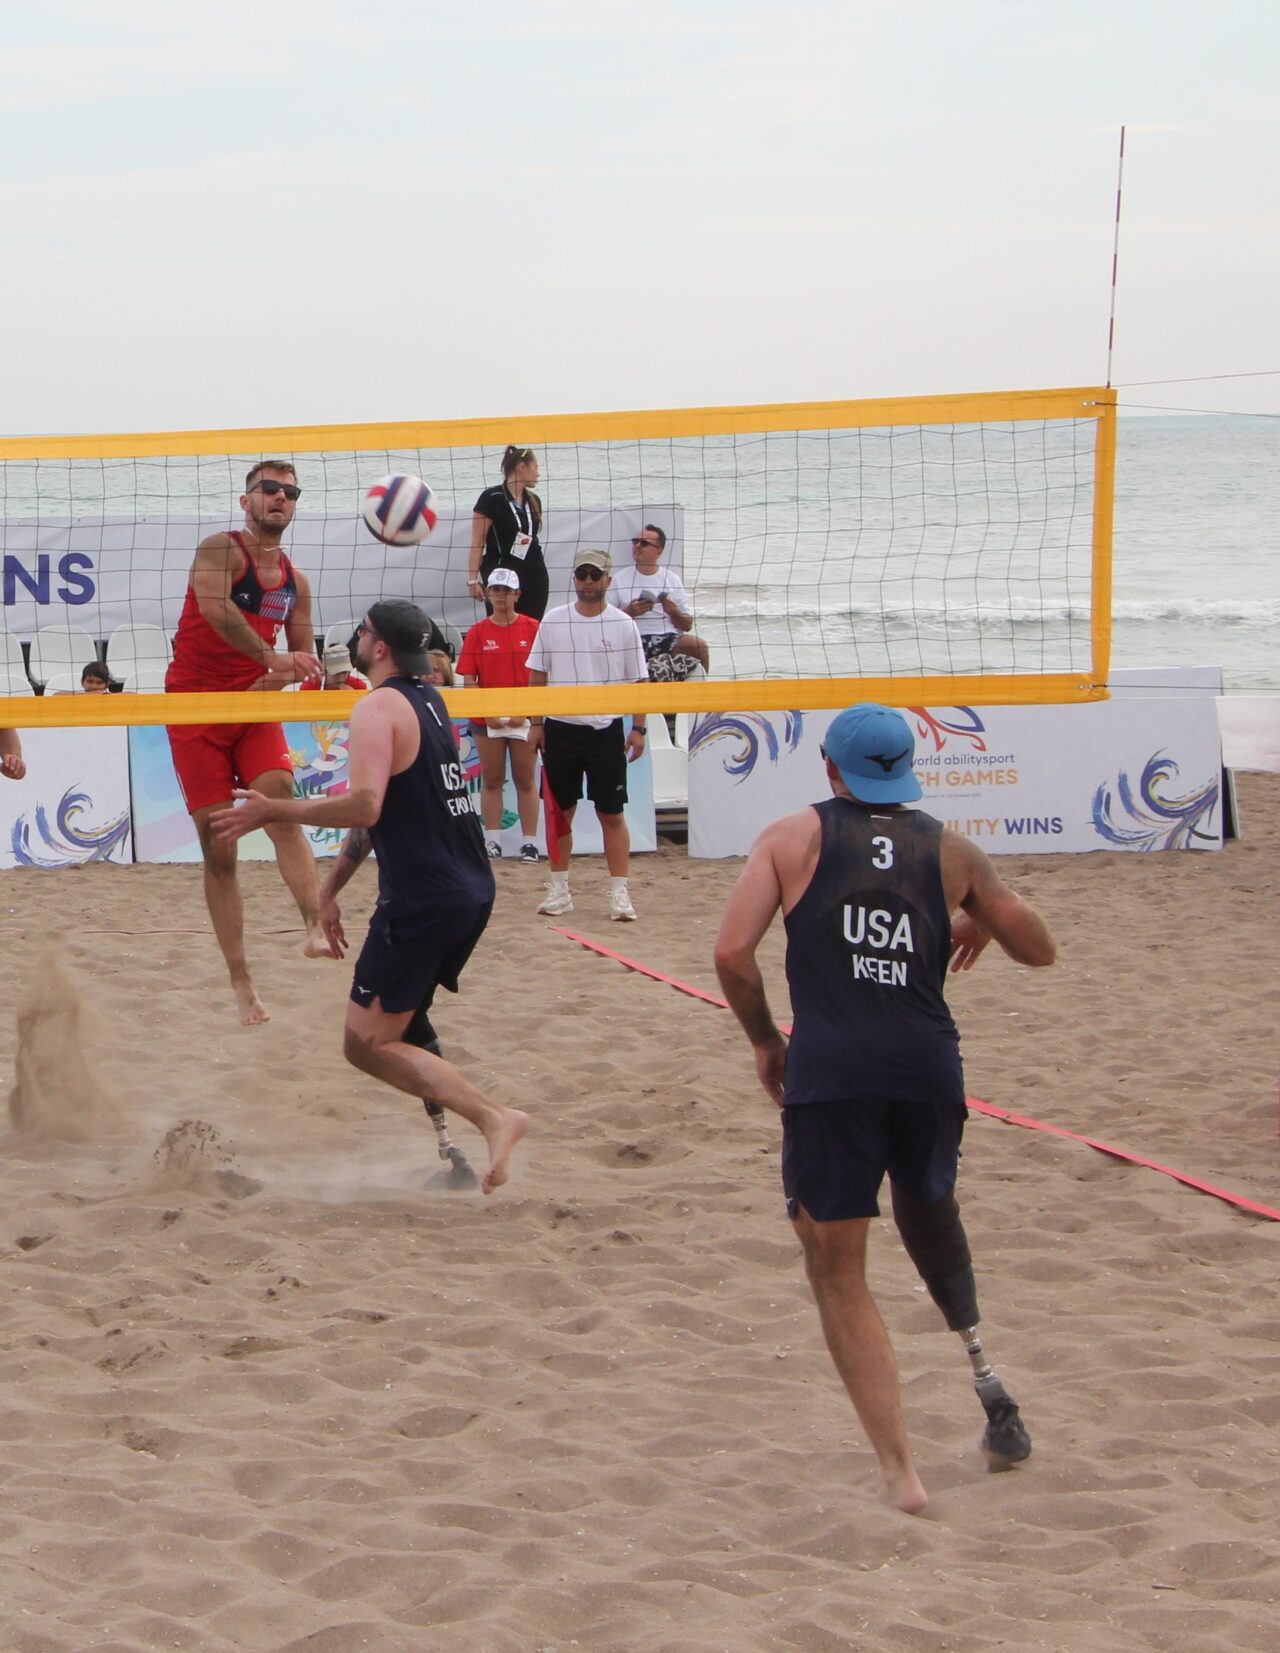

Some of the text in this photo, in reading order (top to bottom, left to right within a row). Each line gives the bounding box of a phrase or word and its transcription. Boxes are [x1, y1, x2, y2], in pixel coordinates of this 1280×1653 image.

[944, 754, 1015, 767] abilitysport
[440, 762, 466, 791] US
[945, 769, 1018, 787] GAMES
[947, 817, 1063, 836] ILITY WINS
[872, 836, 894, 869] 3
[843, 904, 914, 953] USA
[852, 954, 907, 987] KEEN
